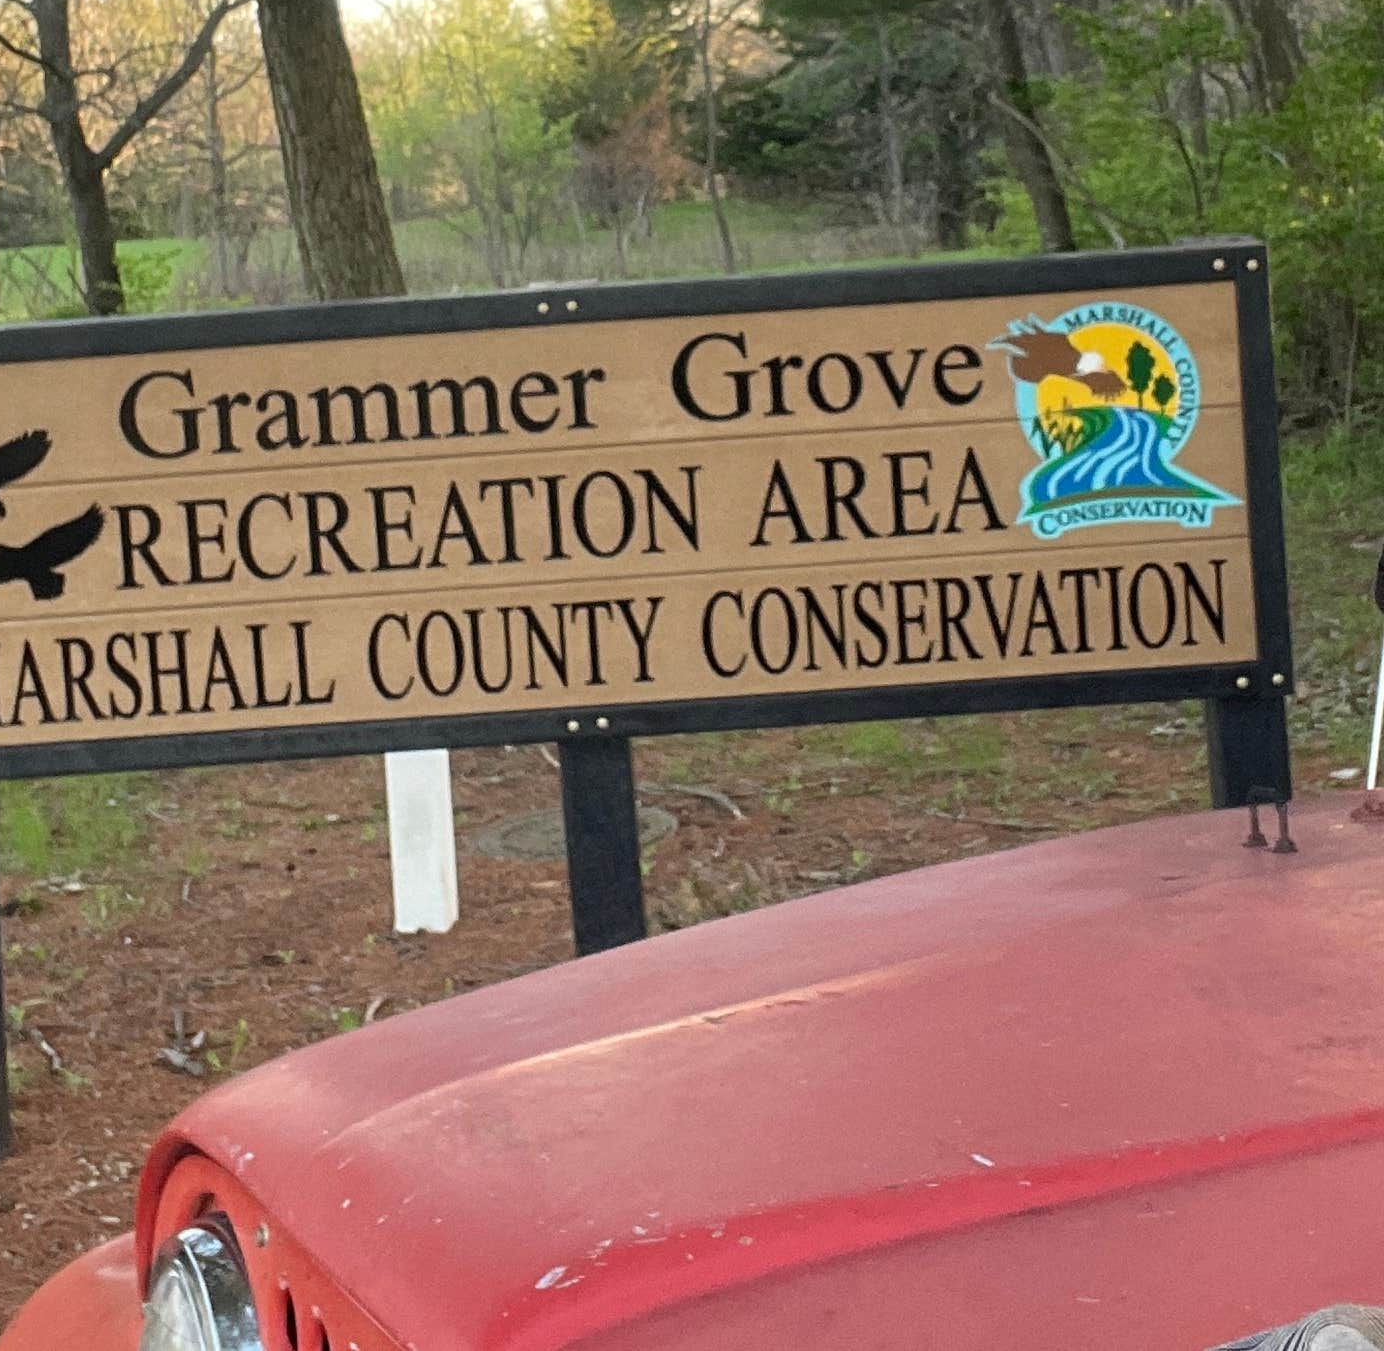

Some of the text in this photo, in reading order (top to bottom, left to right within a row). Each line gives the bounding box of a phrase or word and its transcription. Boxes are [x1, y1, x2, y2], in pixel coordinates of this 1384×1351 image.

[119, 333, 983, 460] Grammer Grove
[1066, 305, 1195, 447] MARSHALL COUNTY
[112, 446, 1008, 590] RECREATION AREA
[1038, 501, 1208, 535] CONSERVATION
[369, 596, 664, 701] COUNTY
[702, 560, 1228, 679] CONSERVATION
